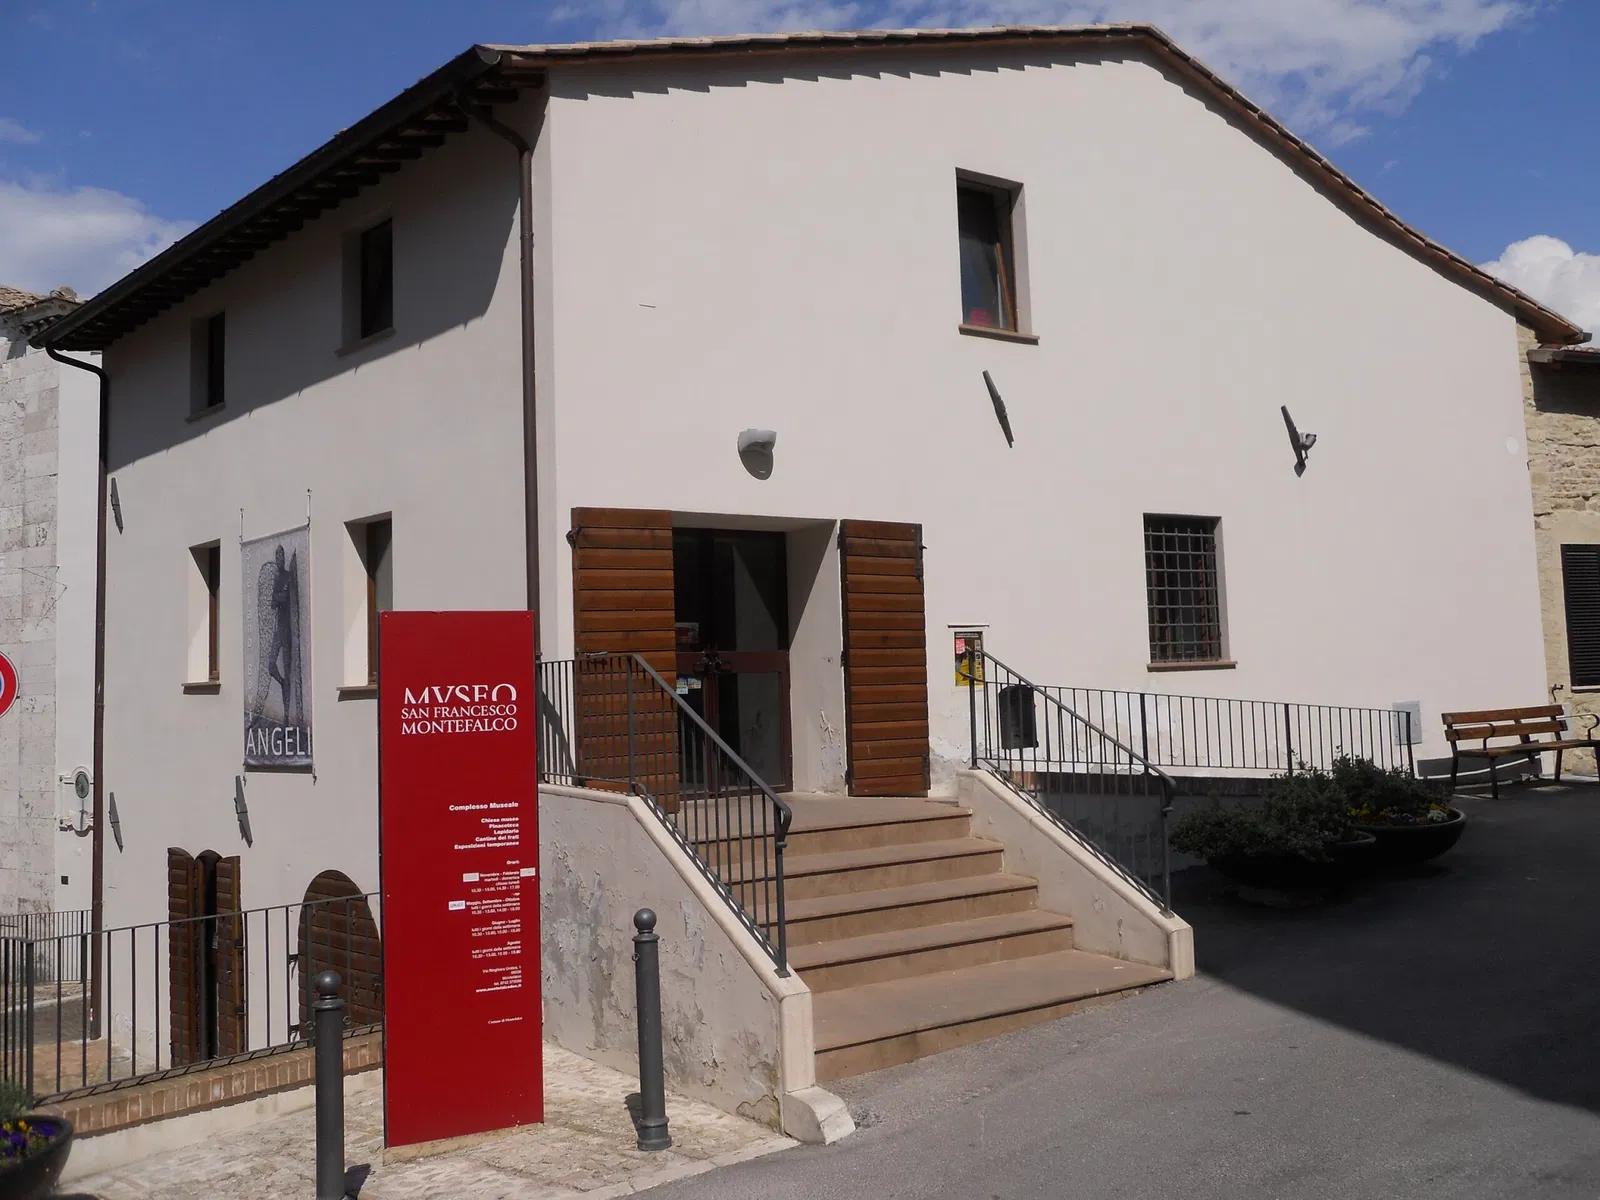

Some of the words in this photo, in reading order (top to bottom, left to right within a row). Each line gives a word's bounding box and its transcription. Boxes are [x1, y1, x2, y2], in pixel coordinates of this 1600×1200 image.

[401, 707, 429, 720] SAN
[433, 703, 517, 718] FRANCESCO
[401, 717, 517, 735] MONTEFALCO
[245, 726, 311, 756] ANGELI
